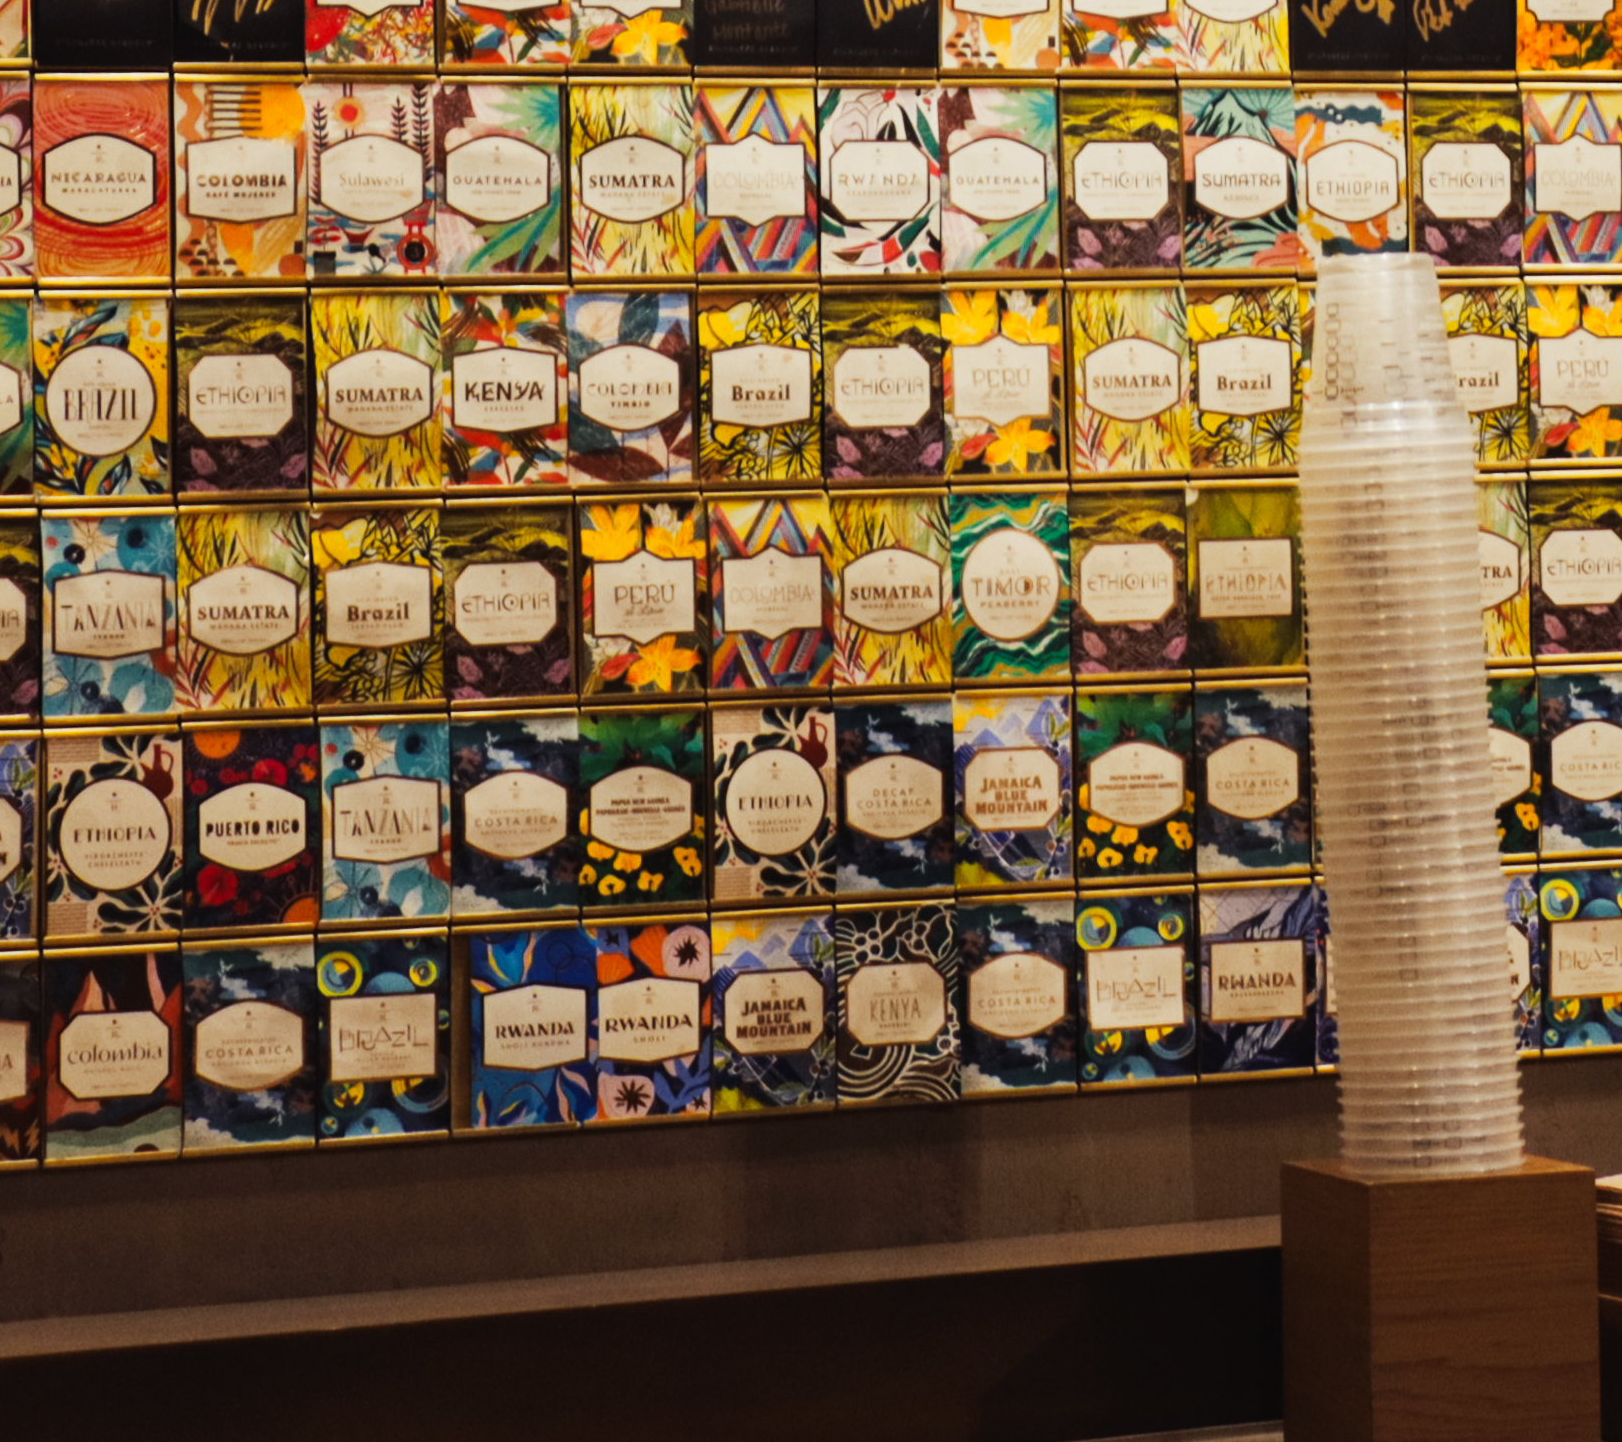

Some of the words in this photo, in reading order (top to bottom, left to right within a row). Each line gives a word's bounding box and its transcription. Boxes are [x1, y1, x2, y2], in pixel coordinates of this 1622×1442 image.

[1217, 374, 1271, 390] Brazil
[465, 382, 542, 401] KENYA
[739, 795, 812, 810] ETHIOPIA
[206, 822, 260, 836] PUERTO
[267, 820, 299, 833] RICO
[742, 998, 806, 1016] JAMAICA
[605, 1015, 692, 1032] RWANDA
[758, 1013, 790, 1025] BLUE
[737, 1023, 811, 1038] MOUNTAIN
[67, 1043, 162, 1064] colombia
